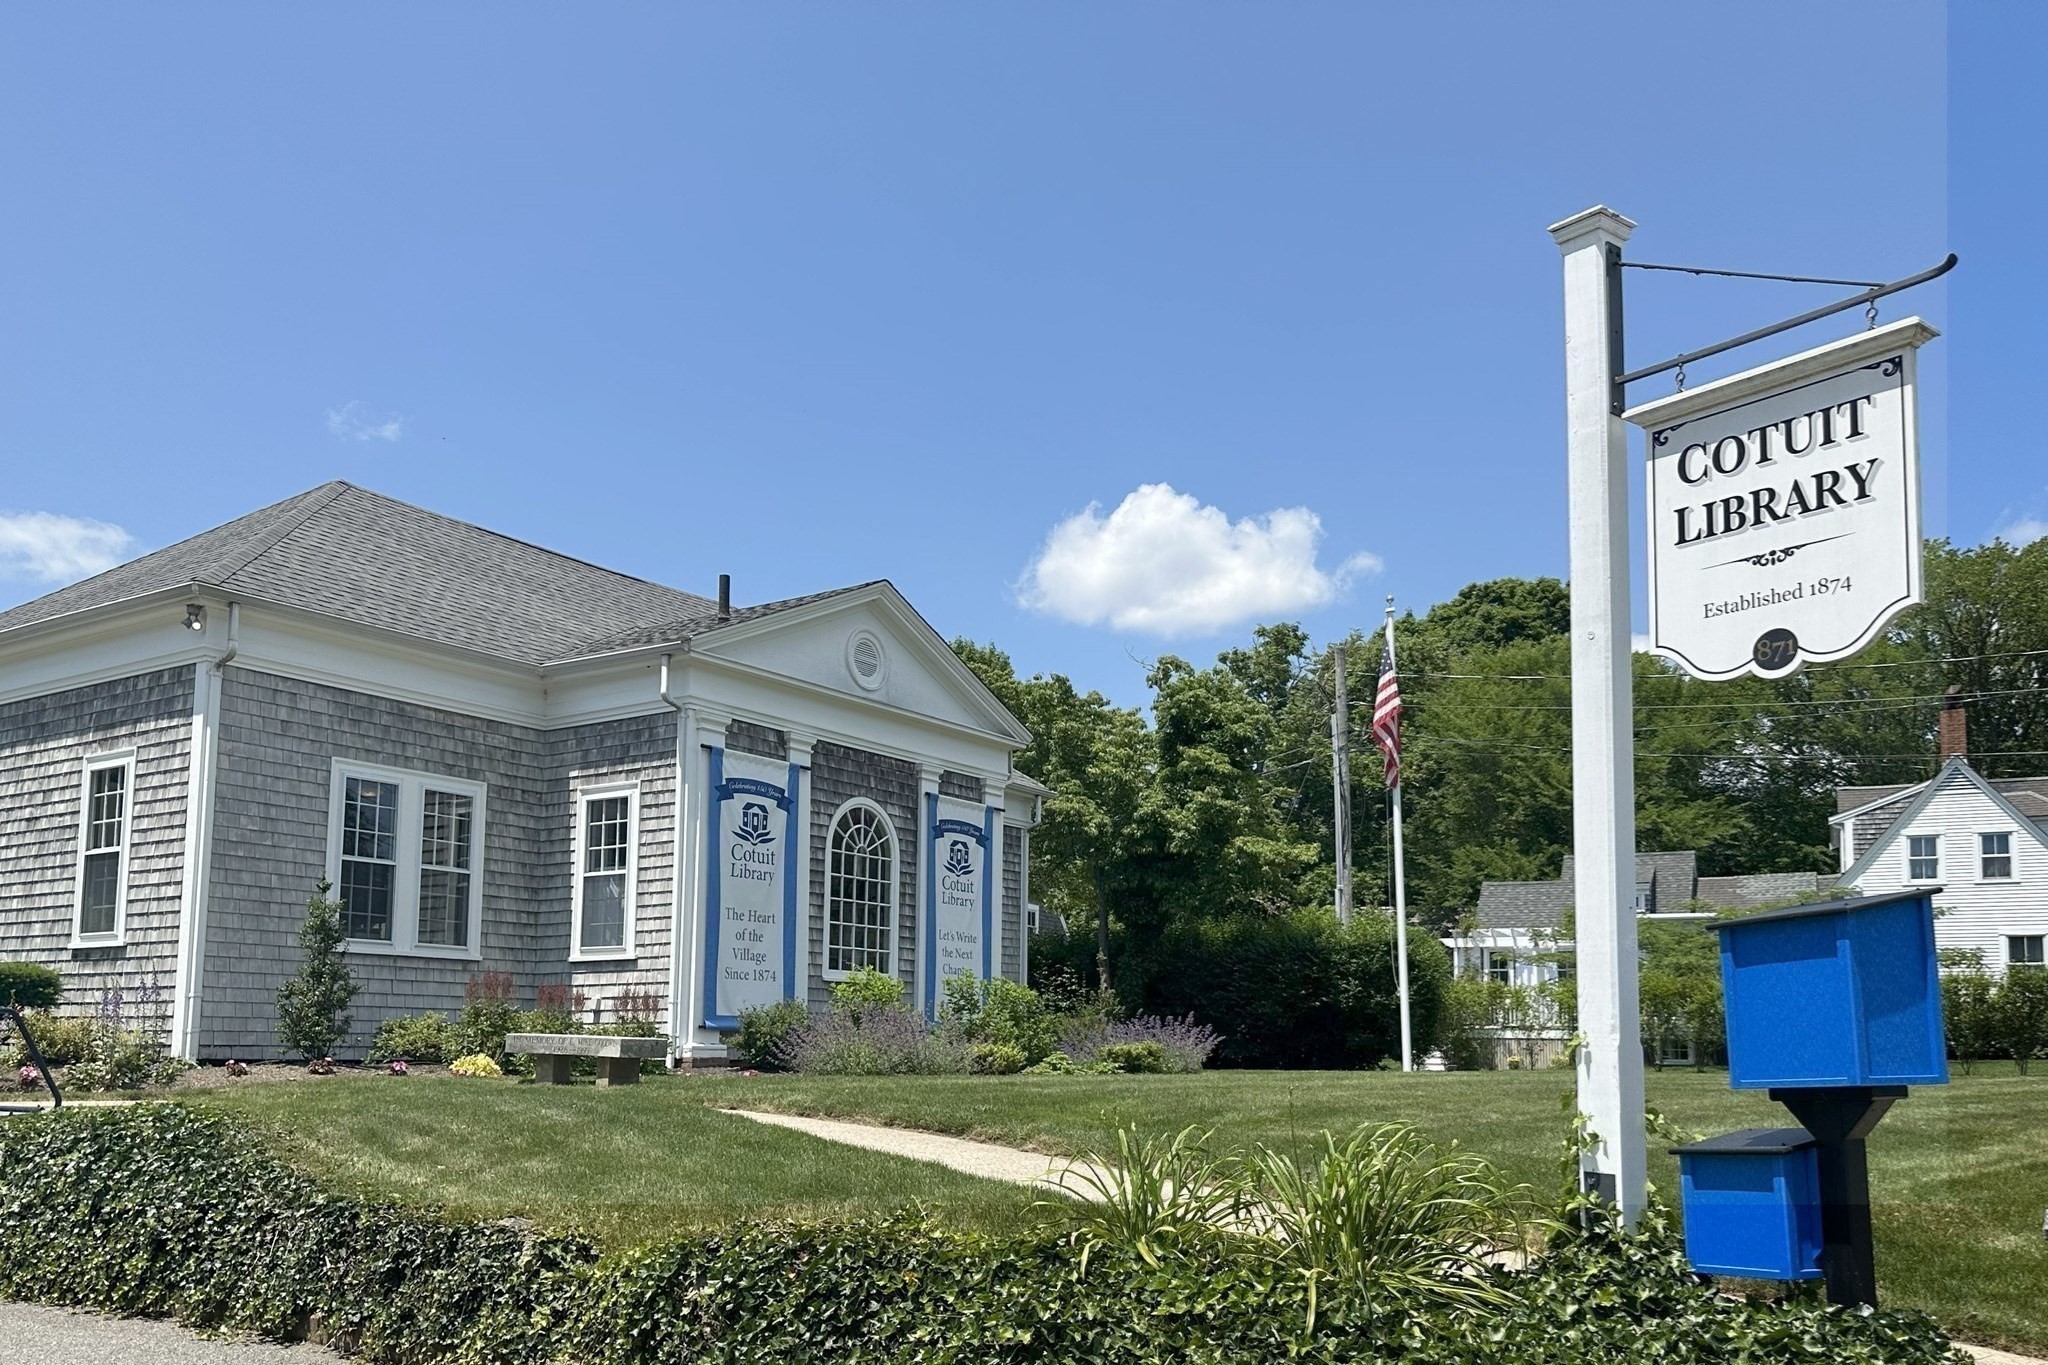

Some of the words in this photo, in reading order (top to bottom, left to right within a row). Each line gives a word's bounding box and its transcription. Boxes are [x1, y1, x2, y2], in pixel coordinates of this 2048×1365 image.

[1677, 395, 1875, 486] COTUIT
[1672, 457, 1882, 548] LIBRARY
[1702, 583, 1803, 619] Established
[1808, 576, 1853, 598] 1874
[1756, 637, 1796, 662] 871
[728, 781, 757, 793] Celebrating
[756, 785, 767, 793] 150
[767, 787, 782, 799] Years
[731, 843, 776, 867] Cotuit
[730, 862, 775, 887] Library
[941, 875, 975, 894] Cotuit
[941, 891, 975, 912] Library
[725, 906, 745, 923] The
[748, 909, 776, 925] Heart
[735, 928, 748, 942] of
[748, 929, 764, 943] the
[938, 928, 955, 942] Let's
[956, 931, 978, 944] Write
[732, 947, 767, 967] Village
[941, 946, 954, 959] the
[955, 947, 974, 960] Next
[724, 966, 750, 981] Since
[752, 969, 777, 983] 1874
